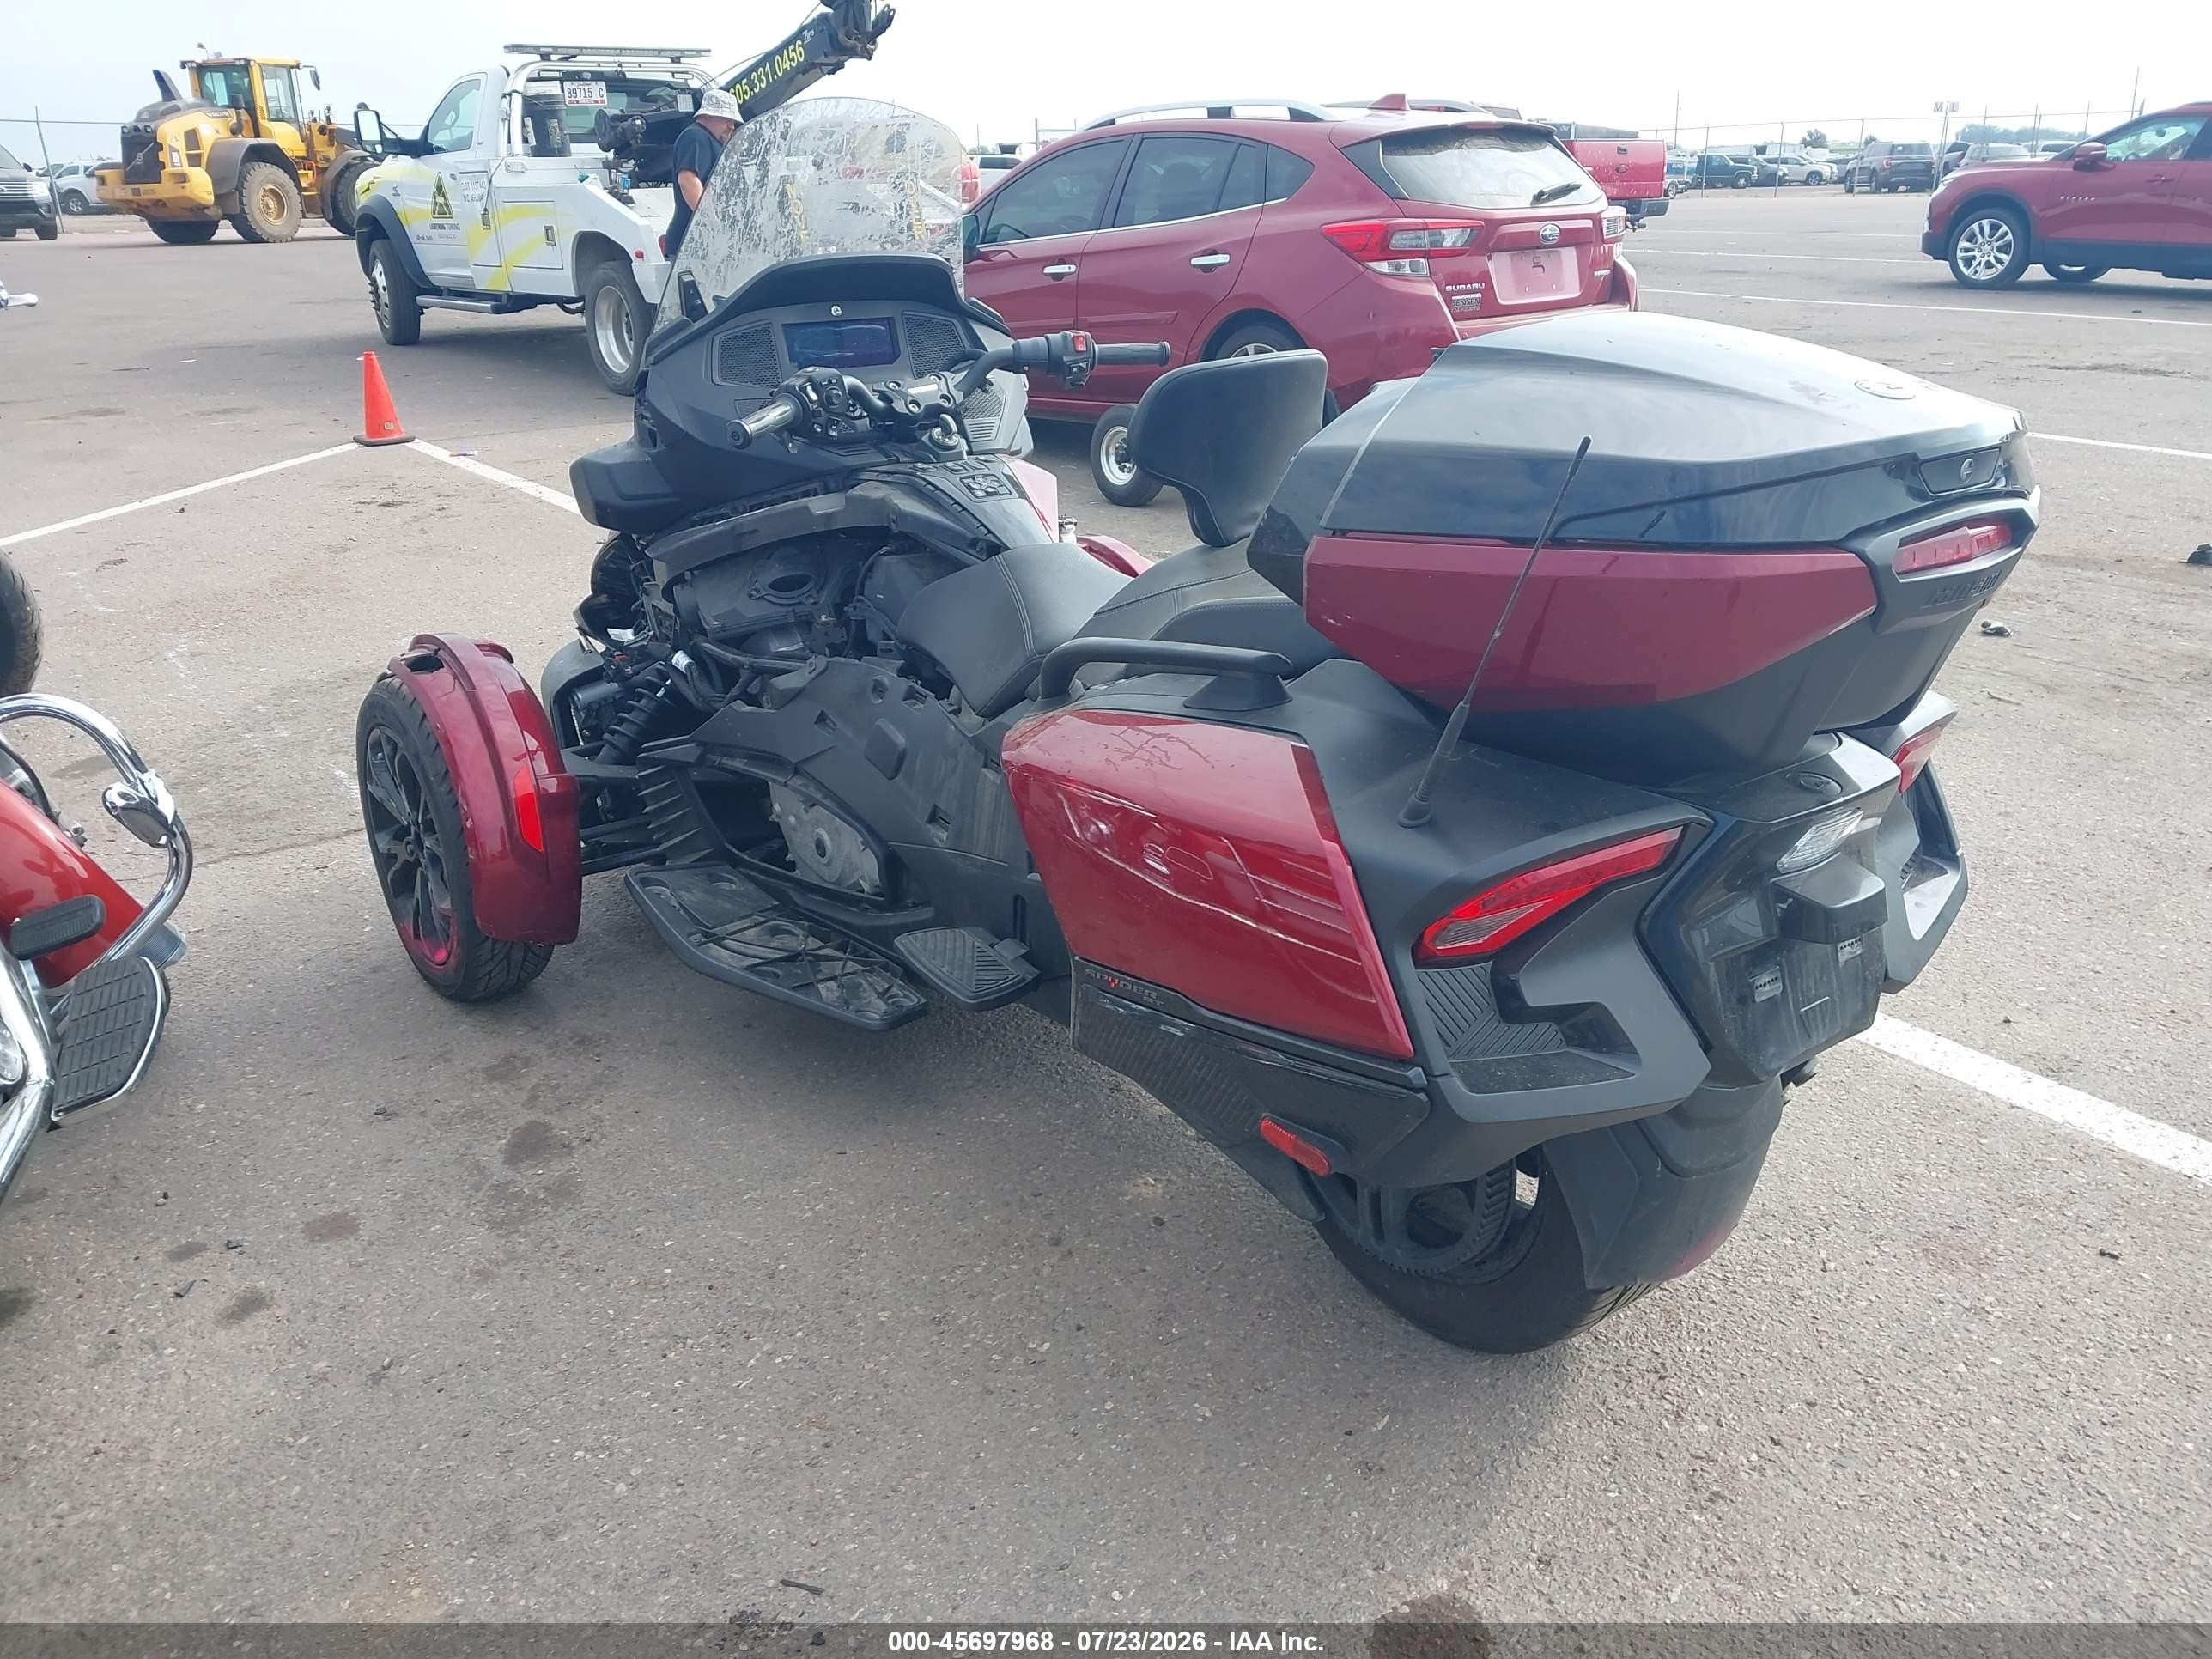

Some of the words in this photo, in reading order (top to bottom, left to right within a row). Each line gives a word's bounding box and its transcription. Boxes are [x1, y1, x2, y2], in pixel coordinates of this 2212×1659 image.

[567, 88, 592, 99] 89715
[599, 88, 605, 99] C
[1933, 102, 1943, 112] M
[1445, 283, 1486, 292] SUBARU
[1453, 297, 1480, 307] JENSEN
[1085, 968, 1158, 999] SPYDER
